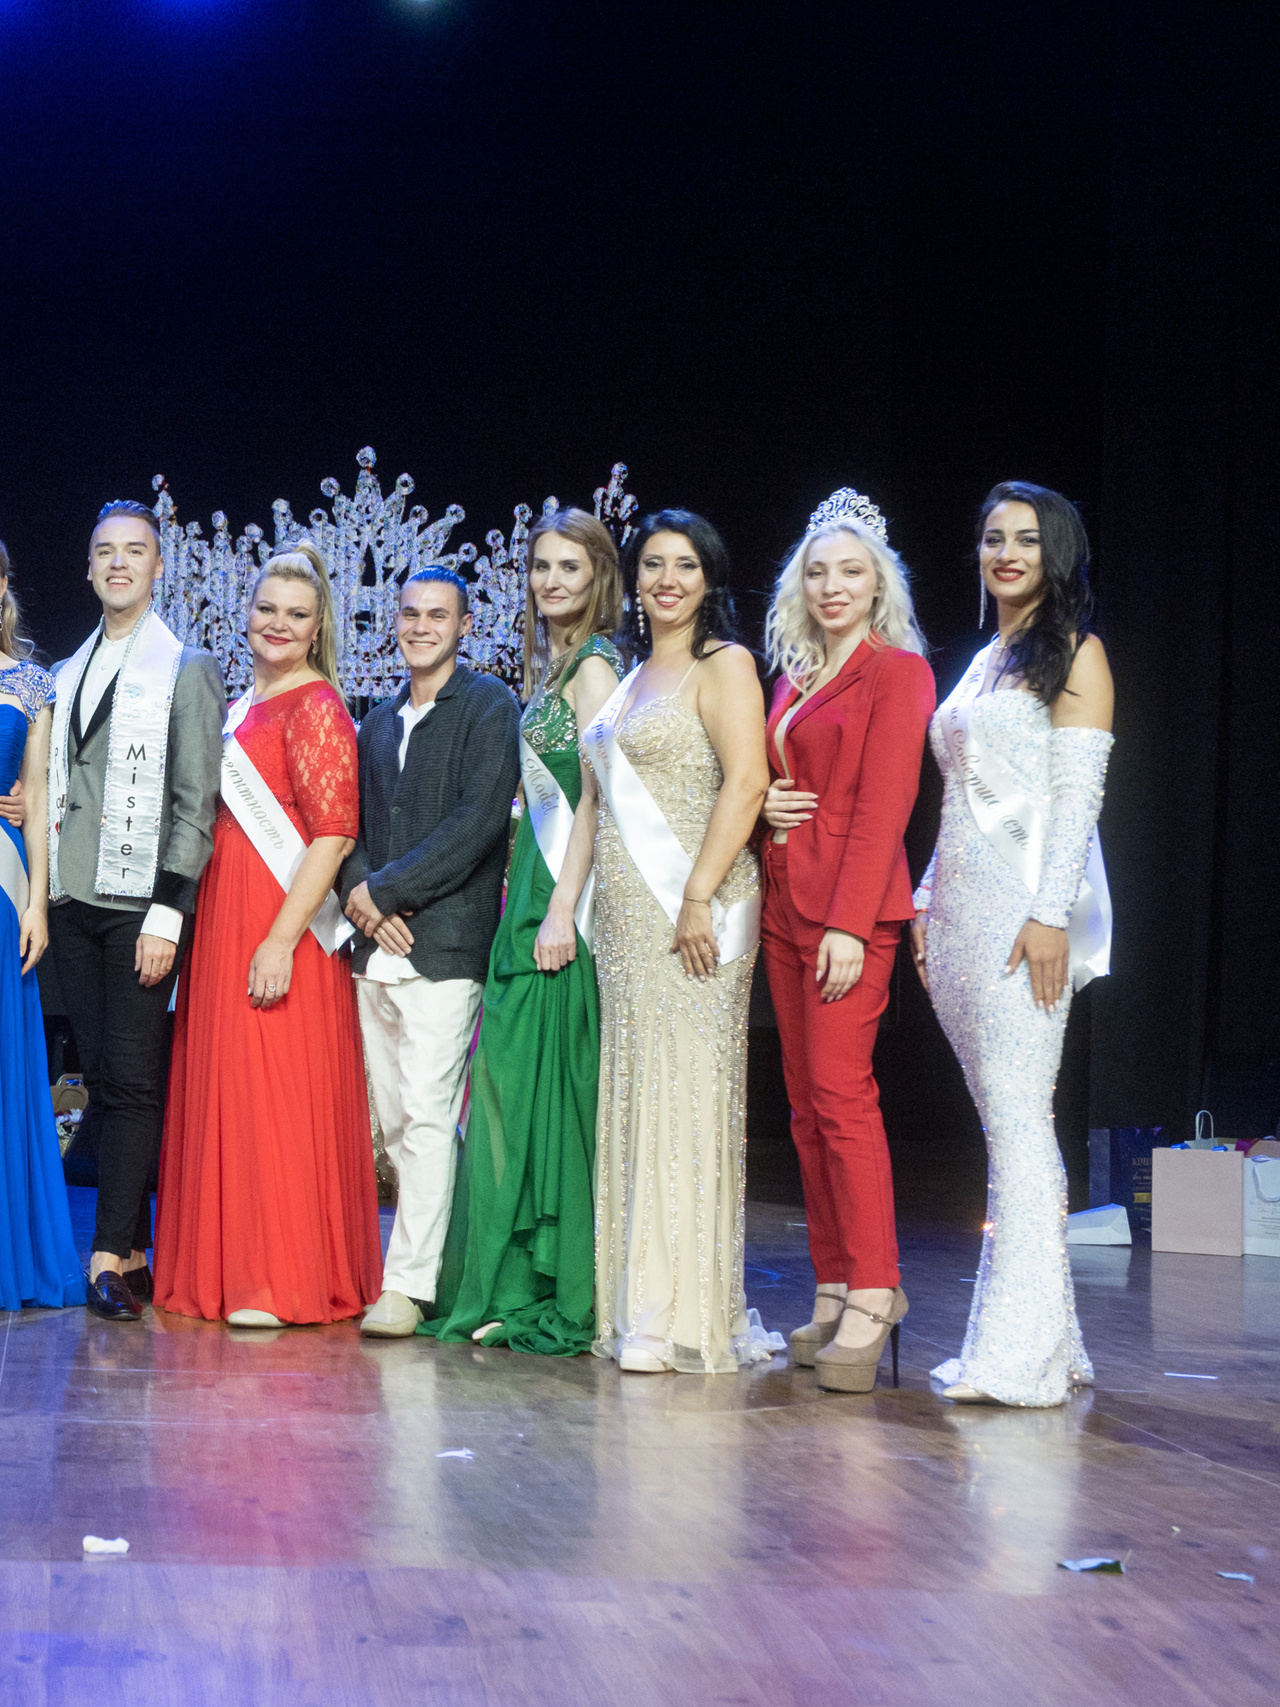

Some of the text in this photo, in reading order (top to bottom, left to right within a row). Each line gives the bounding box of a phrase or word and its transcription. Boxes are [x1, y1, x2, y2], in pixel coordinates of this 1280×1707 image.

[120, 743, 147, 879] Mister
[222, 752, 285, 850] егантность
[520, 758, 559, 816] Model
